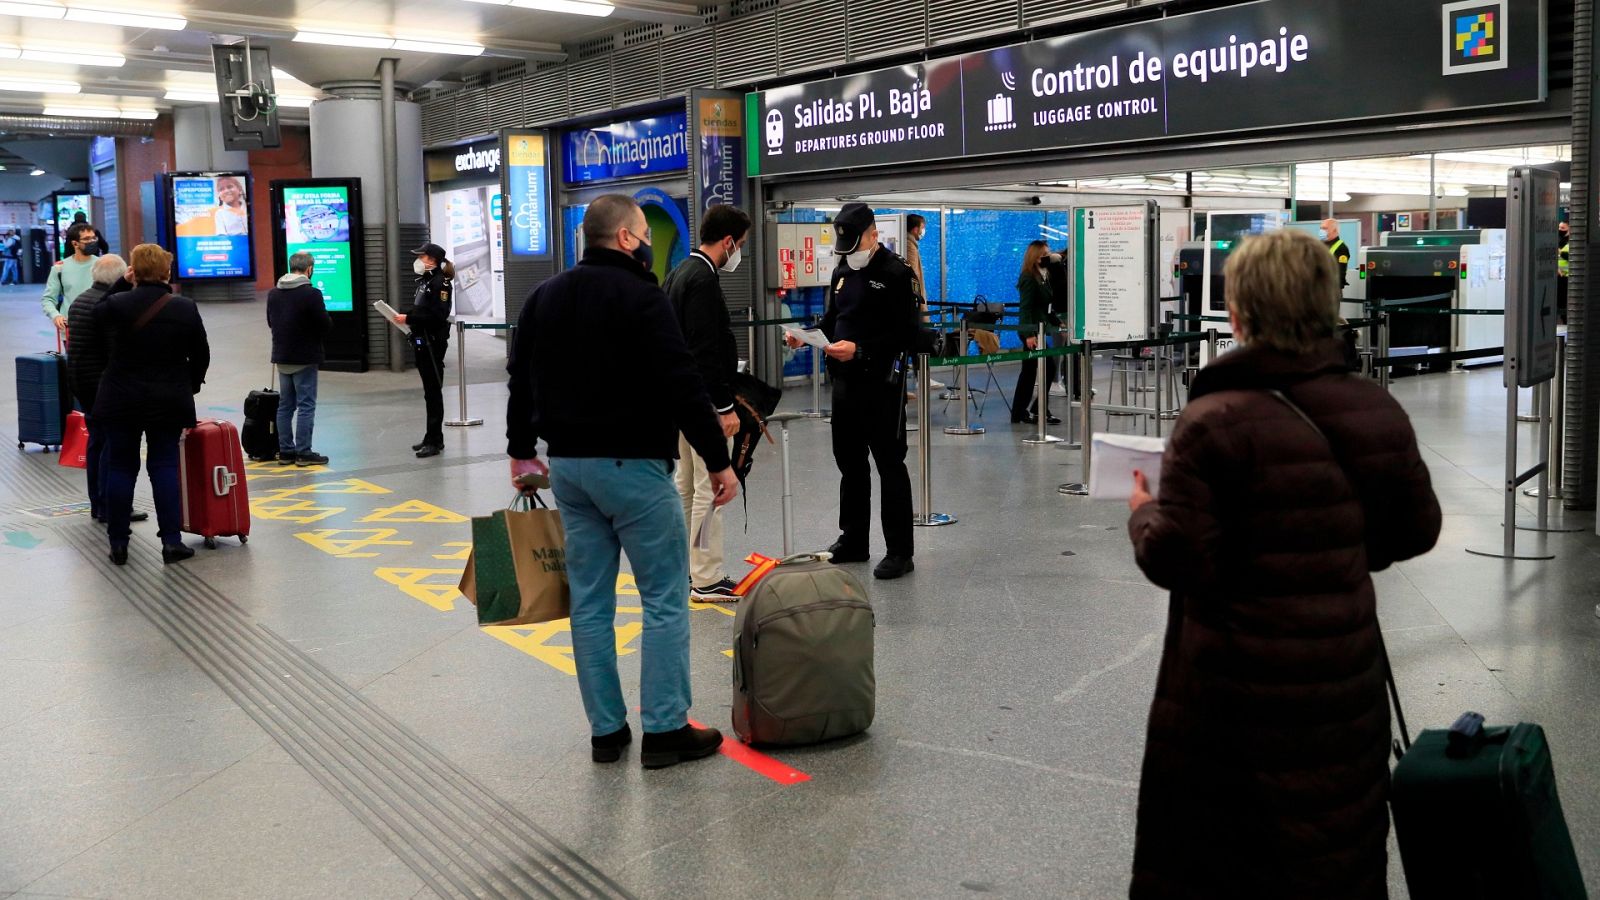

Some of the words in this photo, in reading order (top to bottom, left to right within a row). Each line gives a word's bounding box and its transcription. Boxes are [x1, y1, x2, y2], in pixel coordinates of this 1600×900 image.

[1032, 55, 1118, 98] Control
[1128, 51, 1162, 84] de
[1172, 26, 1308, 83] equipaje
[703, 118, 737, 128] tiendas
[794, 98, 853, 129] Salidas
[859, 91, 883, 120] Pl.
[889, 83, 931, 119] Baja
[1033, 104, 1092, 127] LUGGAGE
[1097, 97, 1158, 119] CONTROL
[612, 124, 689, 170] Imaginari
[795, 133, 858, 153] DEPARTURES
[860, 127, 905, 146] GROUND
[908, 122, 945, 141] FLOOR
[455, 146, 501, 173] exchange
[527, 172, 543, 252] Imaginarium
